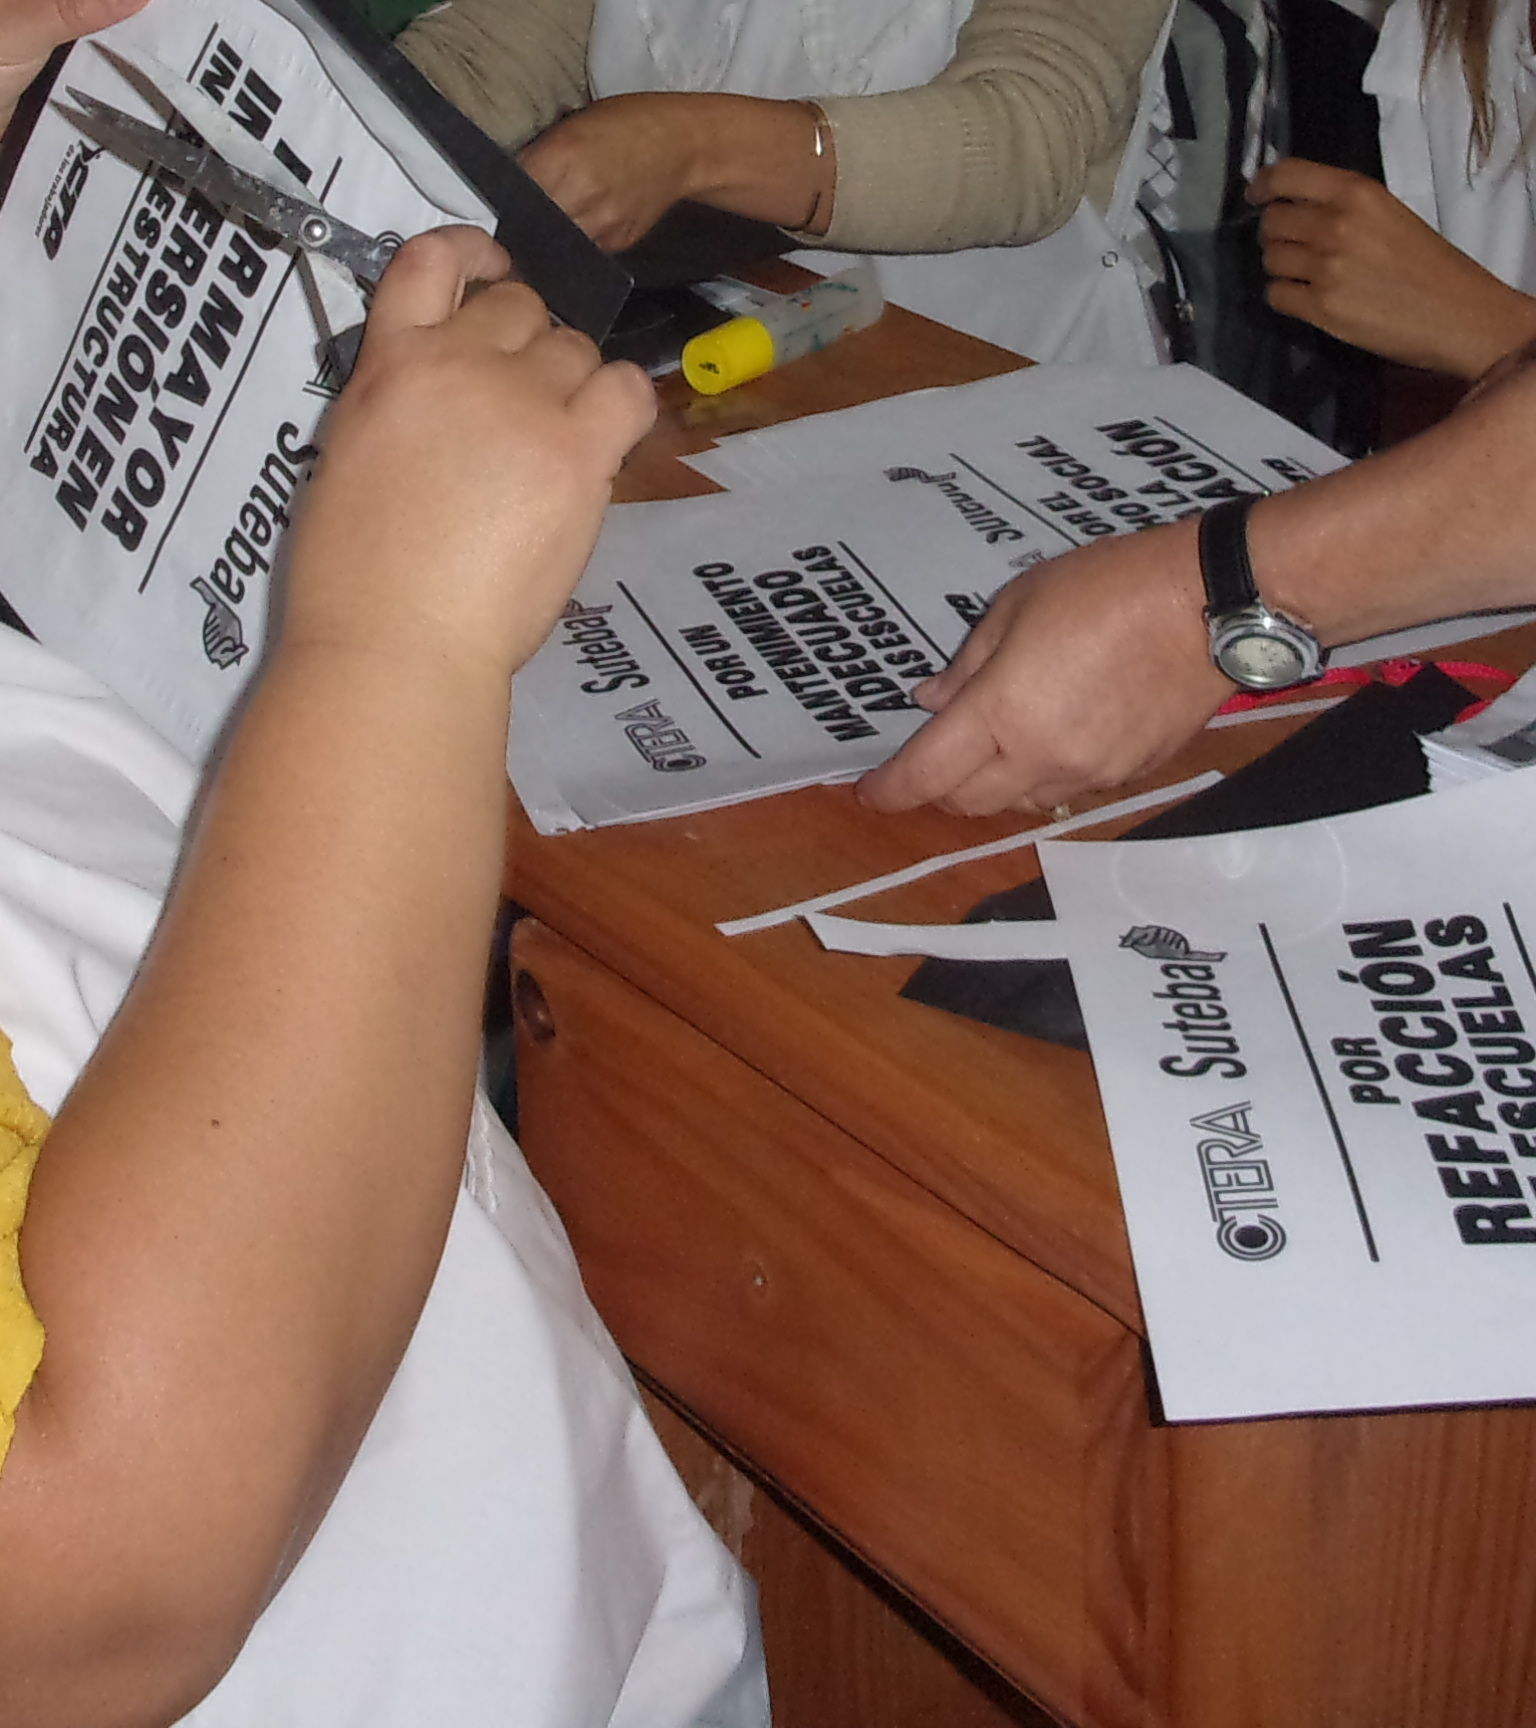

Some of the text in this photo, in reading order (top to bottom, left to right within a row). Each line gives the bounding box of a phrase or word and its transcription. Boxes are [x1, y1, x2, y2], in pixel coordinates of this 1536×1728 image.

[99, 281, 245, 553] MAYOR
[1014, 434, 1129, 502] SOCIAL
[1037, 491, 1084, 512] EL
[752, 569, 923, 712] ADECUADO
[792, 545, 912, 650] ESCUELAS
[562, 615, 650, 694] Suteba
[678, 624, 769, 701] POR UN
[692, 562, 881, 742] MANTENIMIENTO
[1152, 963, 1287, 1262] CTERA Suteba
[1330, 1036, 1401, 1105] POR
